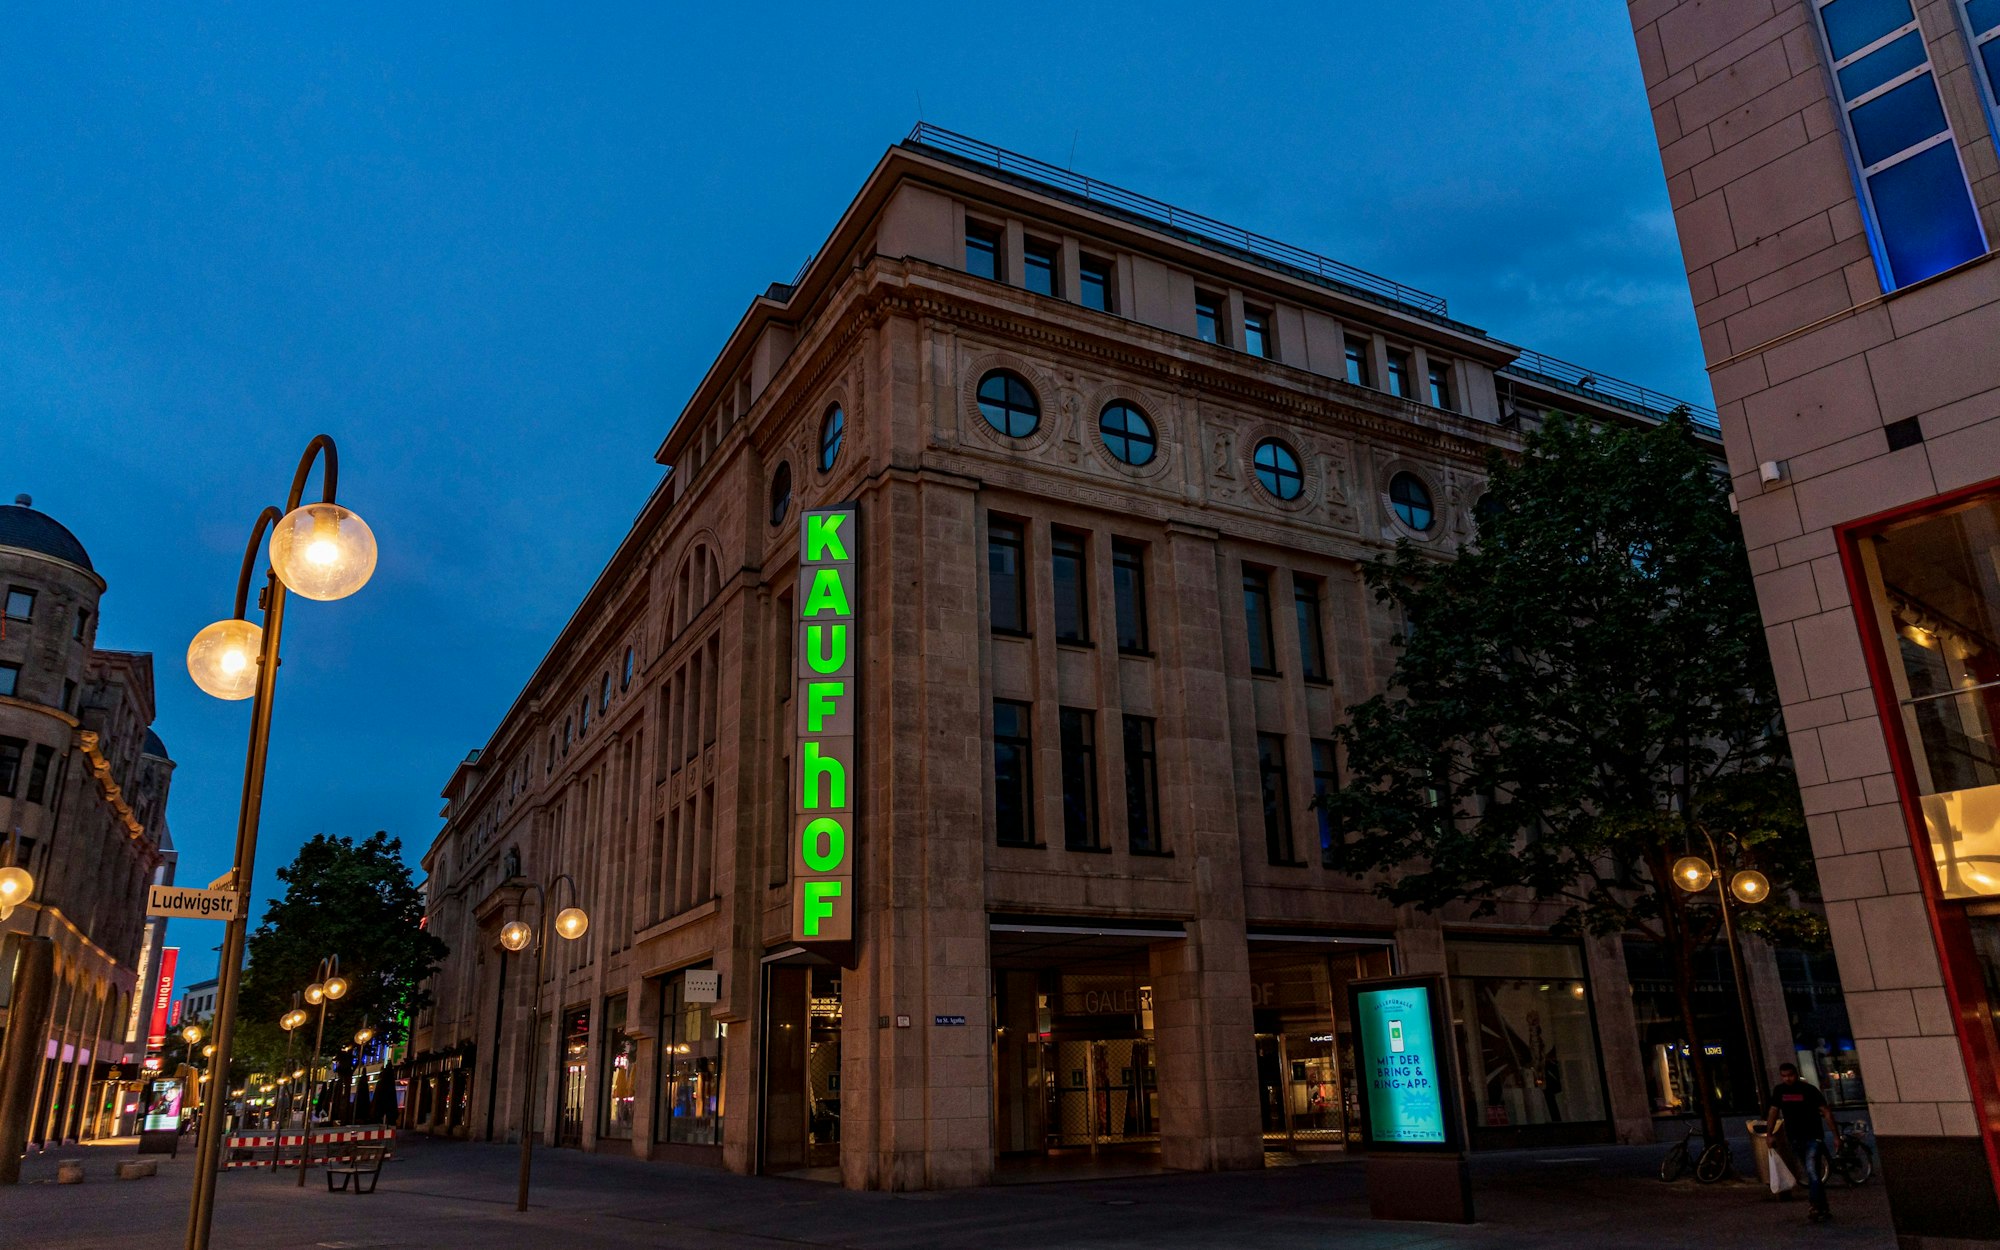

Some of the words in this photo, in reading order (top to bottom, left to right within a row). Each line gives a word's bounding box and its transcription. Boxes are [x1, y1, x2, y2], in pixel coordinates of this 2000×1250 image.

[151, 890, 233, 915] Ludwigstr.
[157, 976, 171, 1009] UNIQLO
[1086, 990, 1152, 1013] GALER
[1252, 982, 1275, 1006] OF
[1377, 1055, 1395, 1065] MIT
[1399, 1055, 1420, 1065] DER
[1377, 1066, 1410, 1077] BRING
[1415, 1066, 1423, 1076] &
[1374, 1078, 1431, 1089] RING-APP.
